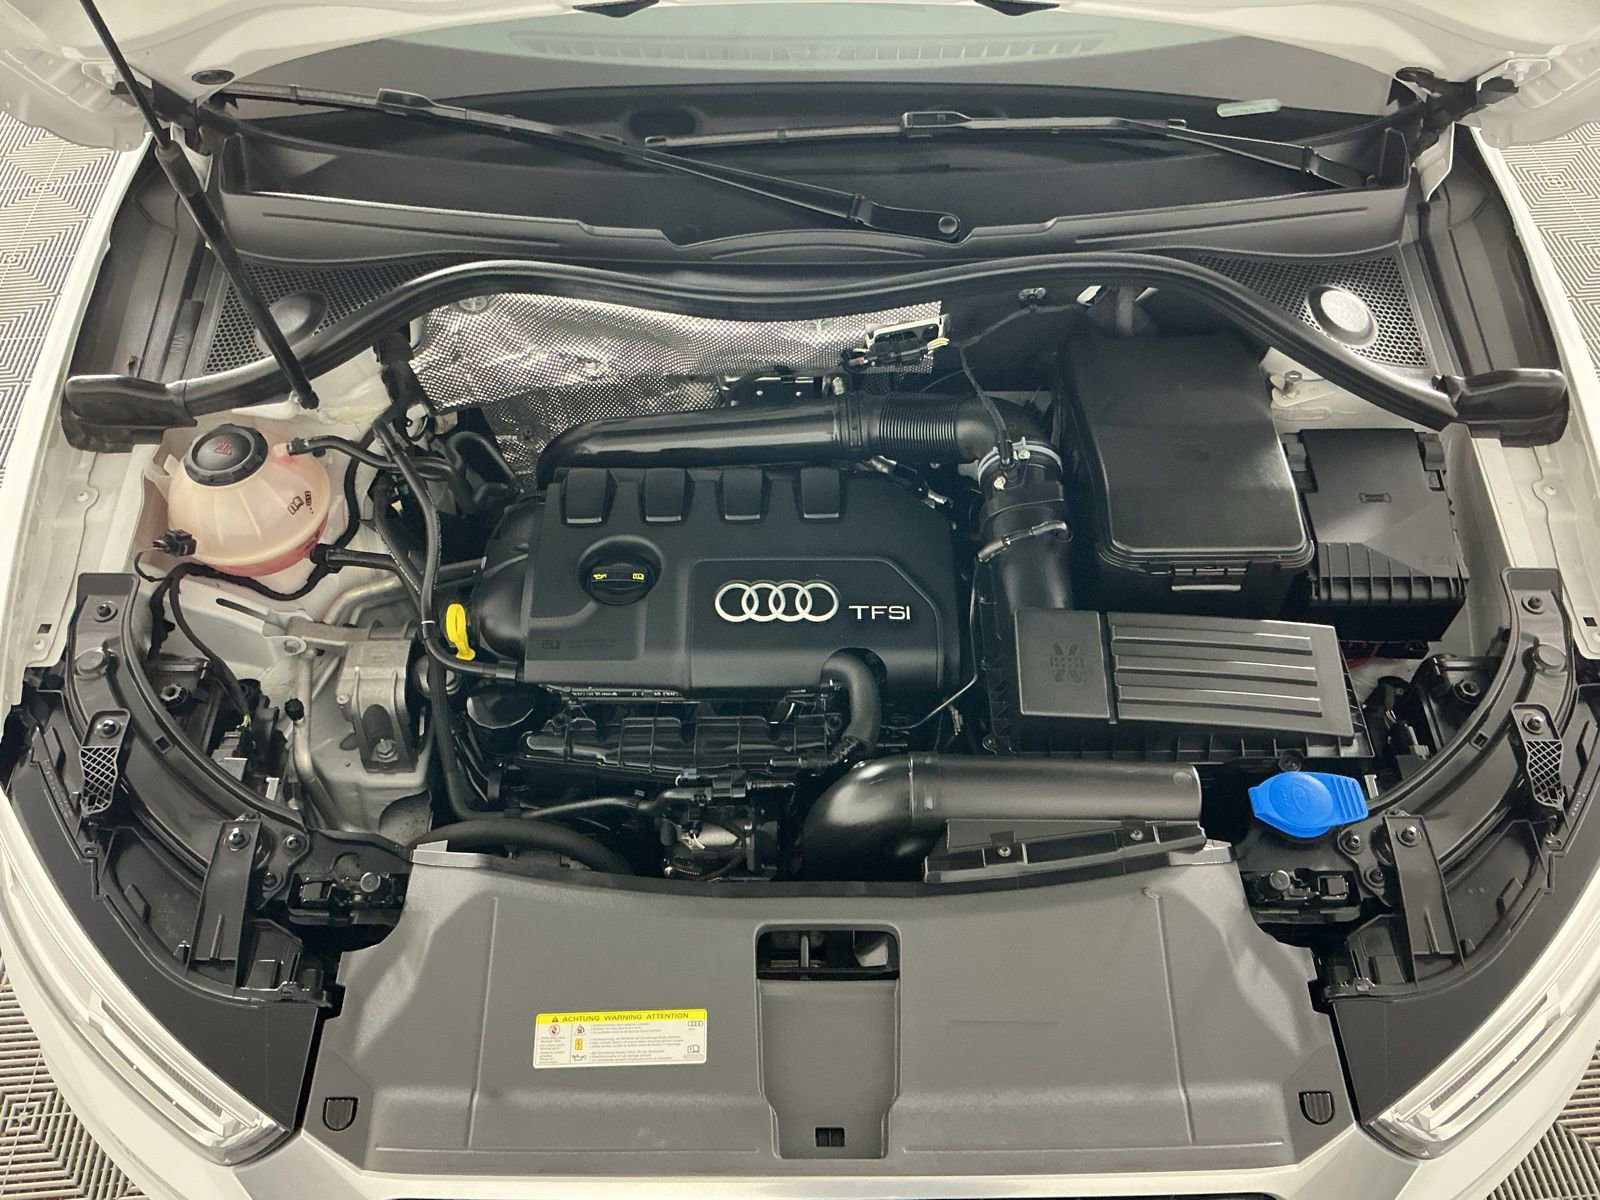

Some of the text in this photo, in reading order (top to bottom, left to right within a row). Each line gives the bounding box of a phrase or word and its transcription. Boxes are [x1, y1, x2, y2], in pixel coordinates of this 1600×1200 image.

[848, 605, 911, 620] TFSI
[562, 1012, 689, 1023] ACHTUNG WARNING ATTENTION
